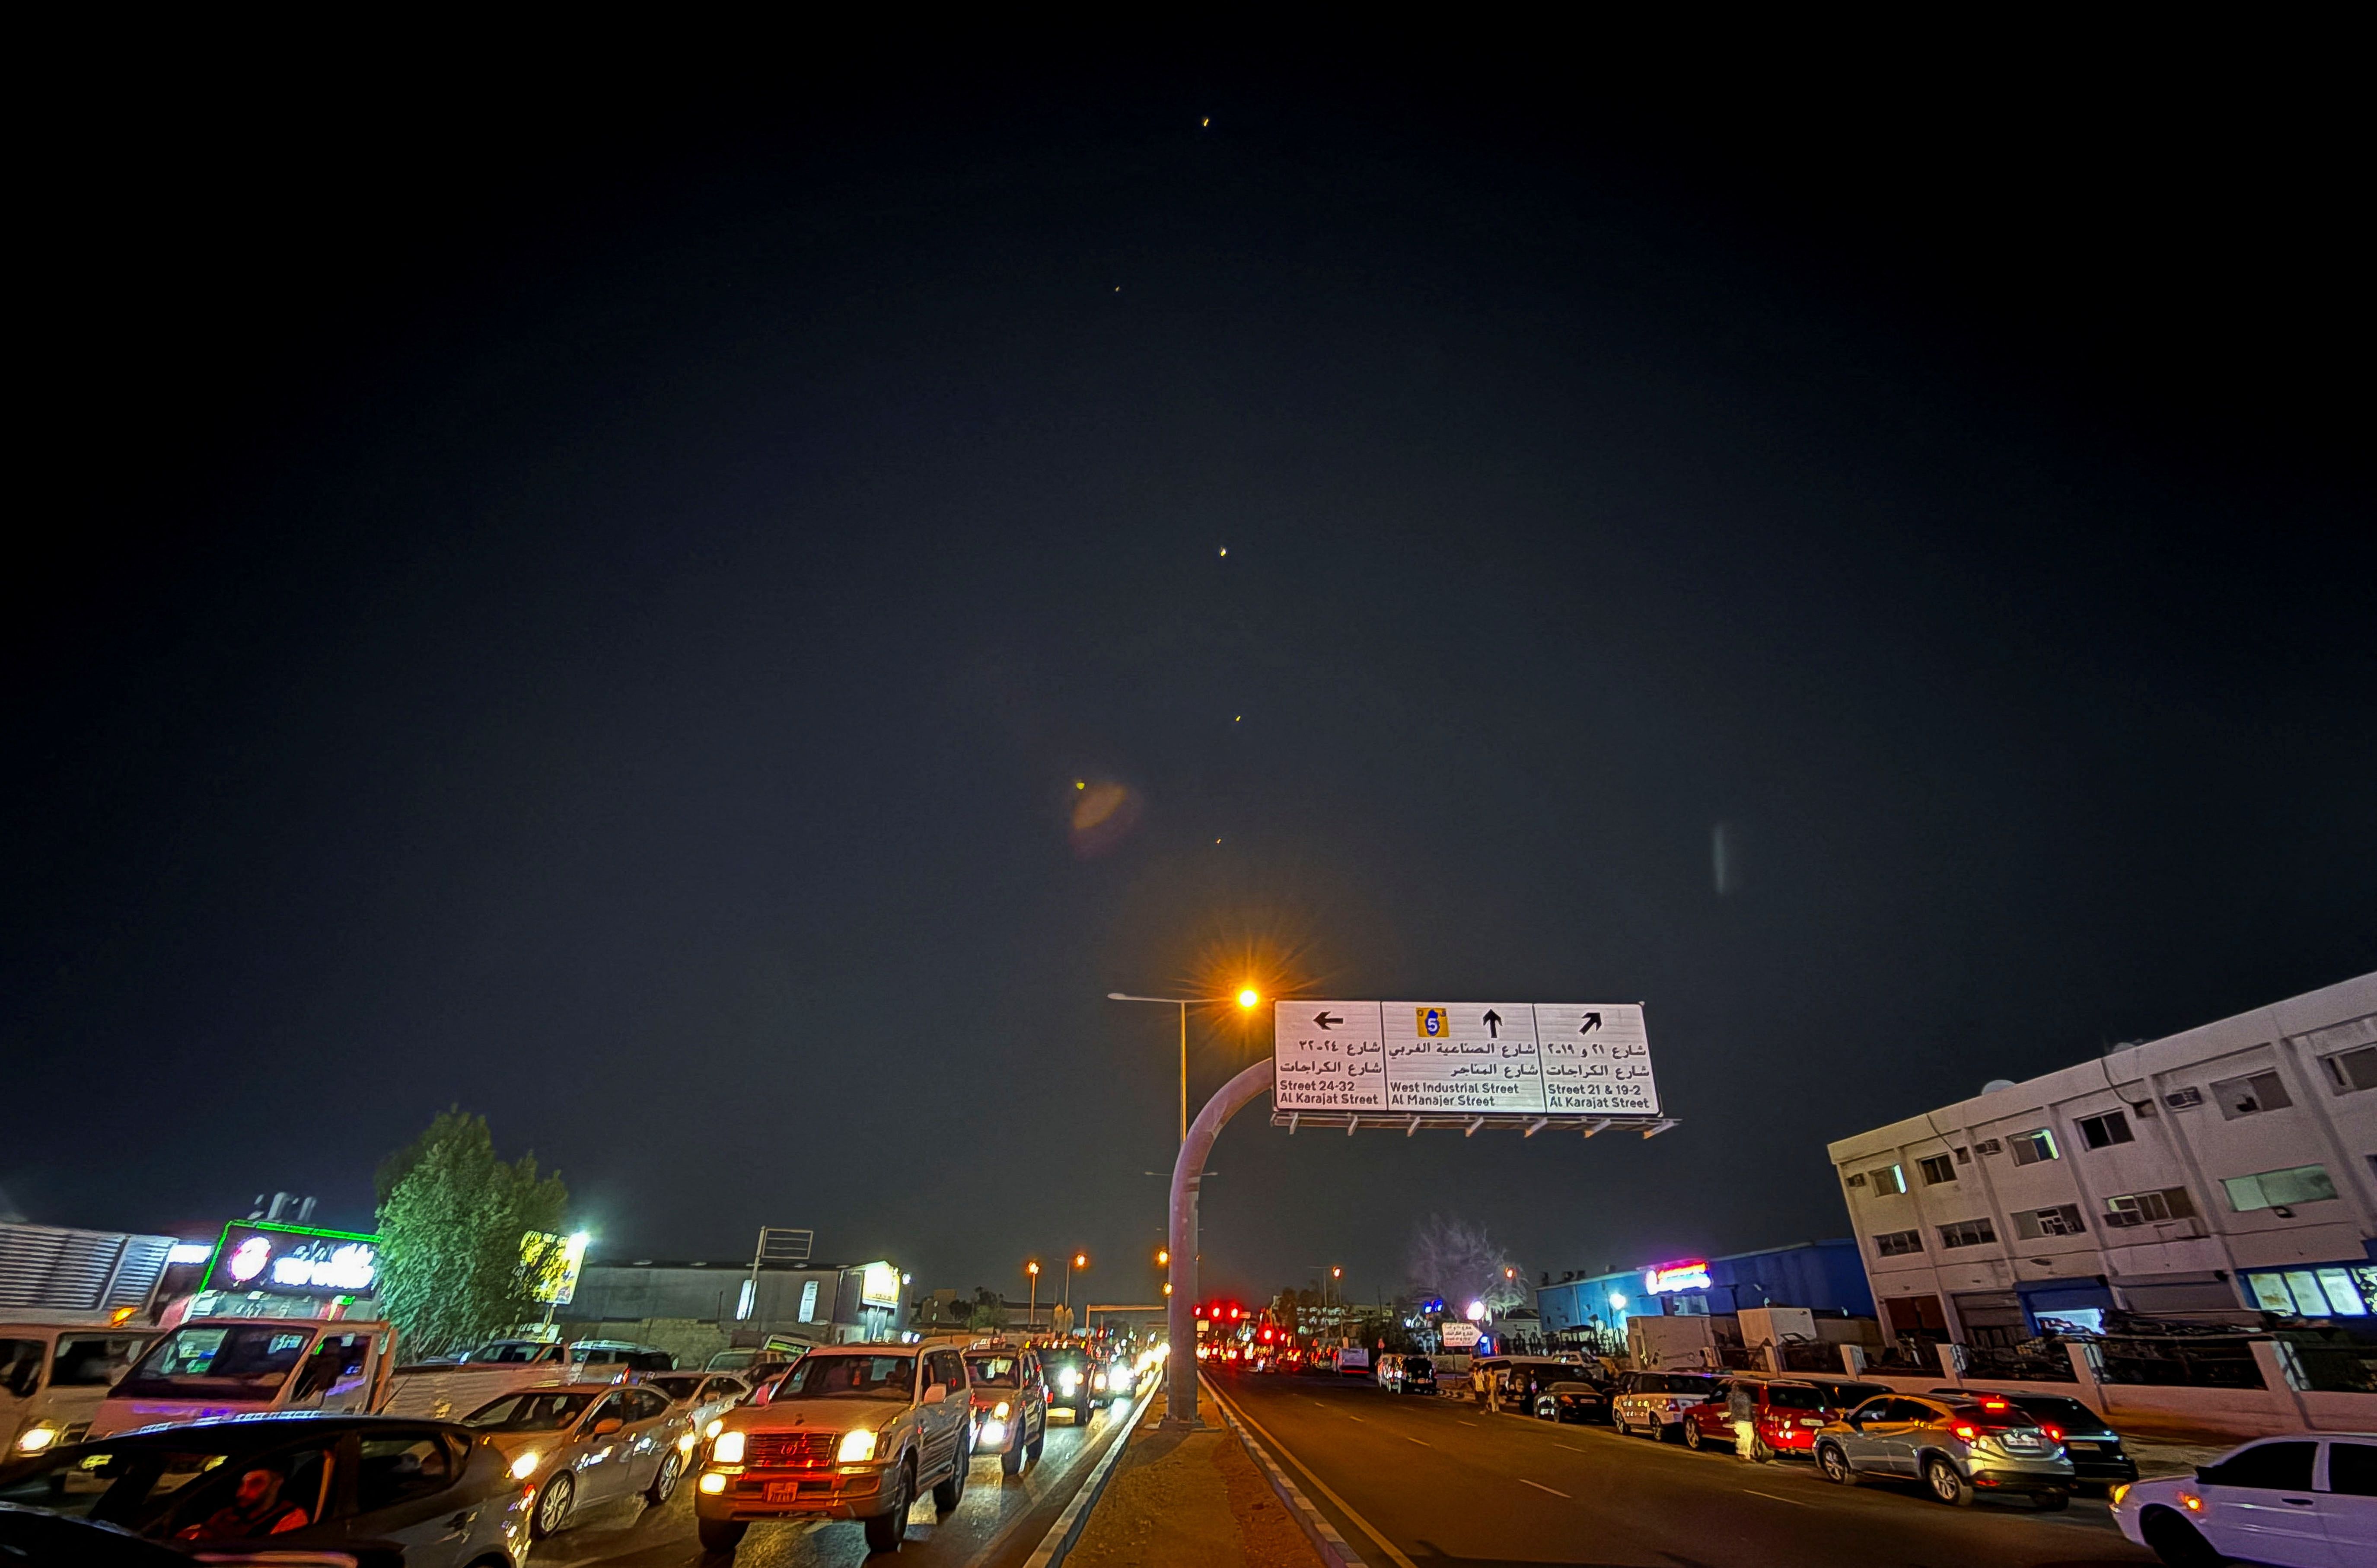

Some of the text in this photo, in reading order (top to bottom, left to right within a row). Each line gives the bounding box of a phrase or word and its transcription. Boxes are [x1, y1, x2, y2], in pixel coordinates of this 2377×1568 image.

[1427, 1018, 1437, 1032] 5
[1347, 1041, 1380, 1056] شارع
[1436, 1042, 1494, 1056] الصناعية
[1501, 1043, 1536, 1058] شارع
[1580, 1049, 1587, 1058] و
[1592, 1044, 1604, 1054] ٢١
[1612, 1045, 1646, 1059] شارع
[1280, 1061, 1382, 1077] شارع الكراجات
[1504, 1064, 1539, 1079] شارع
[1546, 1064, 1650, 1080] شارع الكراجات
[1280, 1080, 1355, 1091] Street 24-32
[1390, 1082, 1519, 1094] West Industrial Street
[1548, 1084, 1641, 1095] Street 21 & 19-2
[1280, 1093, 1378, 1105] Al Karajat Street
[1391, 1095, 1495, 1107] Al Manajer Street
[1550, 1096, 1650, 1109] Al Karajat Street
